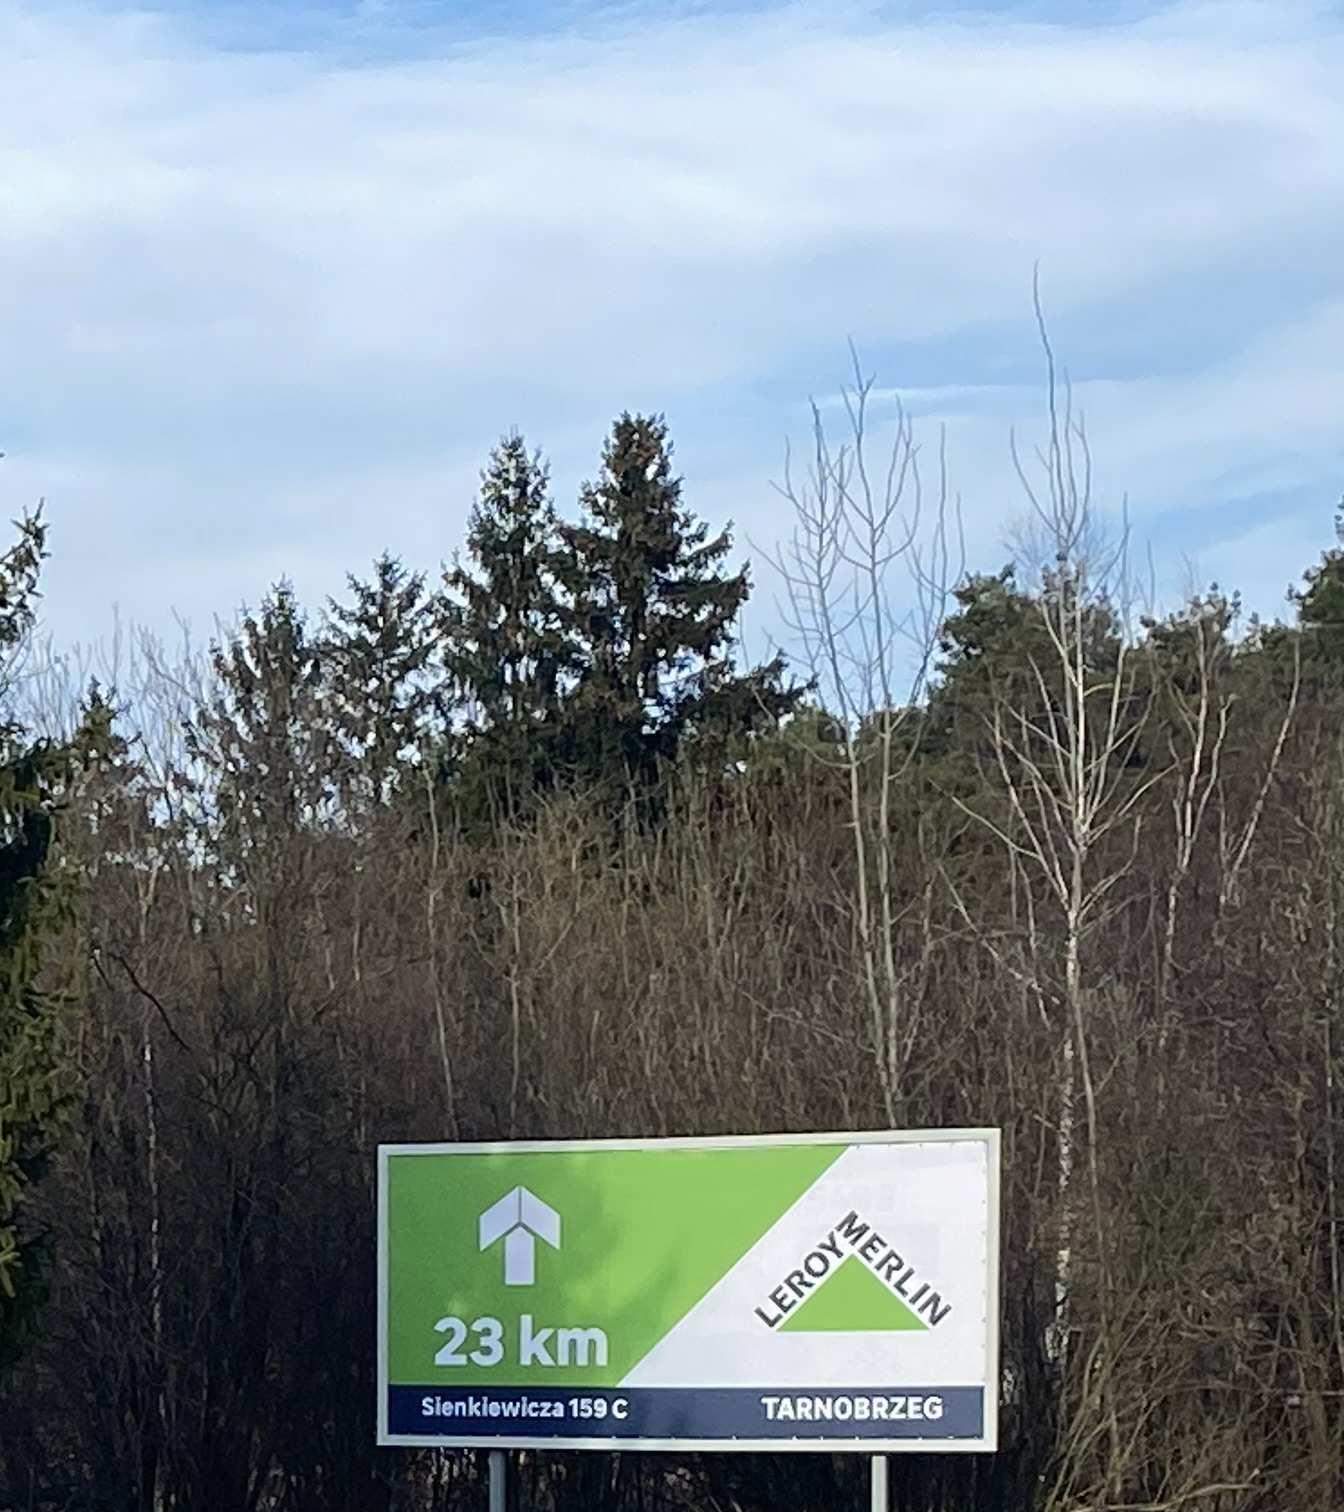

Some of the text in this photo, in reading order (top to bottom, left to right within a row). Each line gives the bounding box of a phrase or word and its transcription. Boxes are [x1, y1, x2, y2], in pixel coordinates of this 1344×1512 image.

[753, 1209, 953, 1329] LEROY MERLIN
[433, 1313, 609, 1367] 23 km
[421, 1396, 629, 1419] Sienkiewicza 159 C
[760, 1395, 944, 1420] TARNOBRZEG
